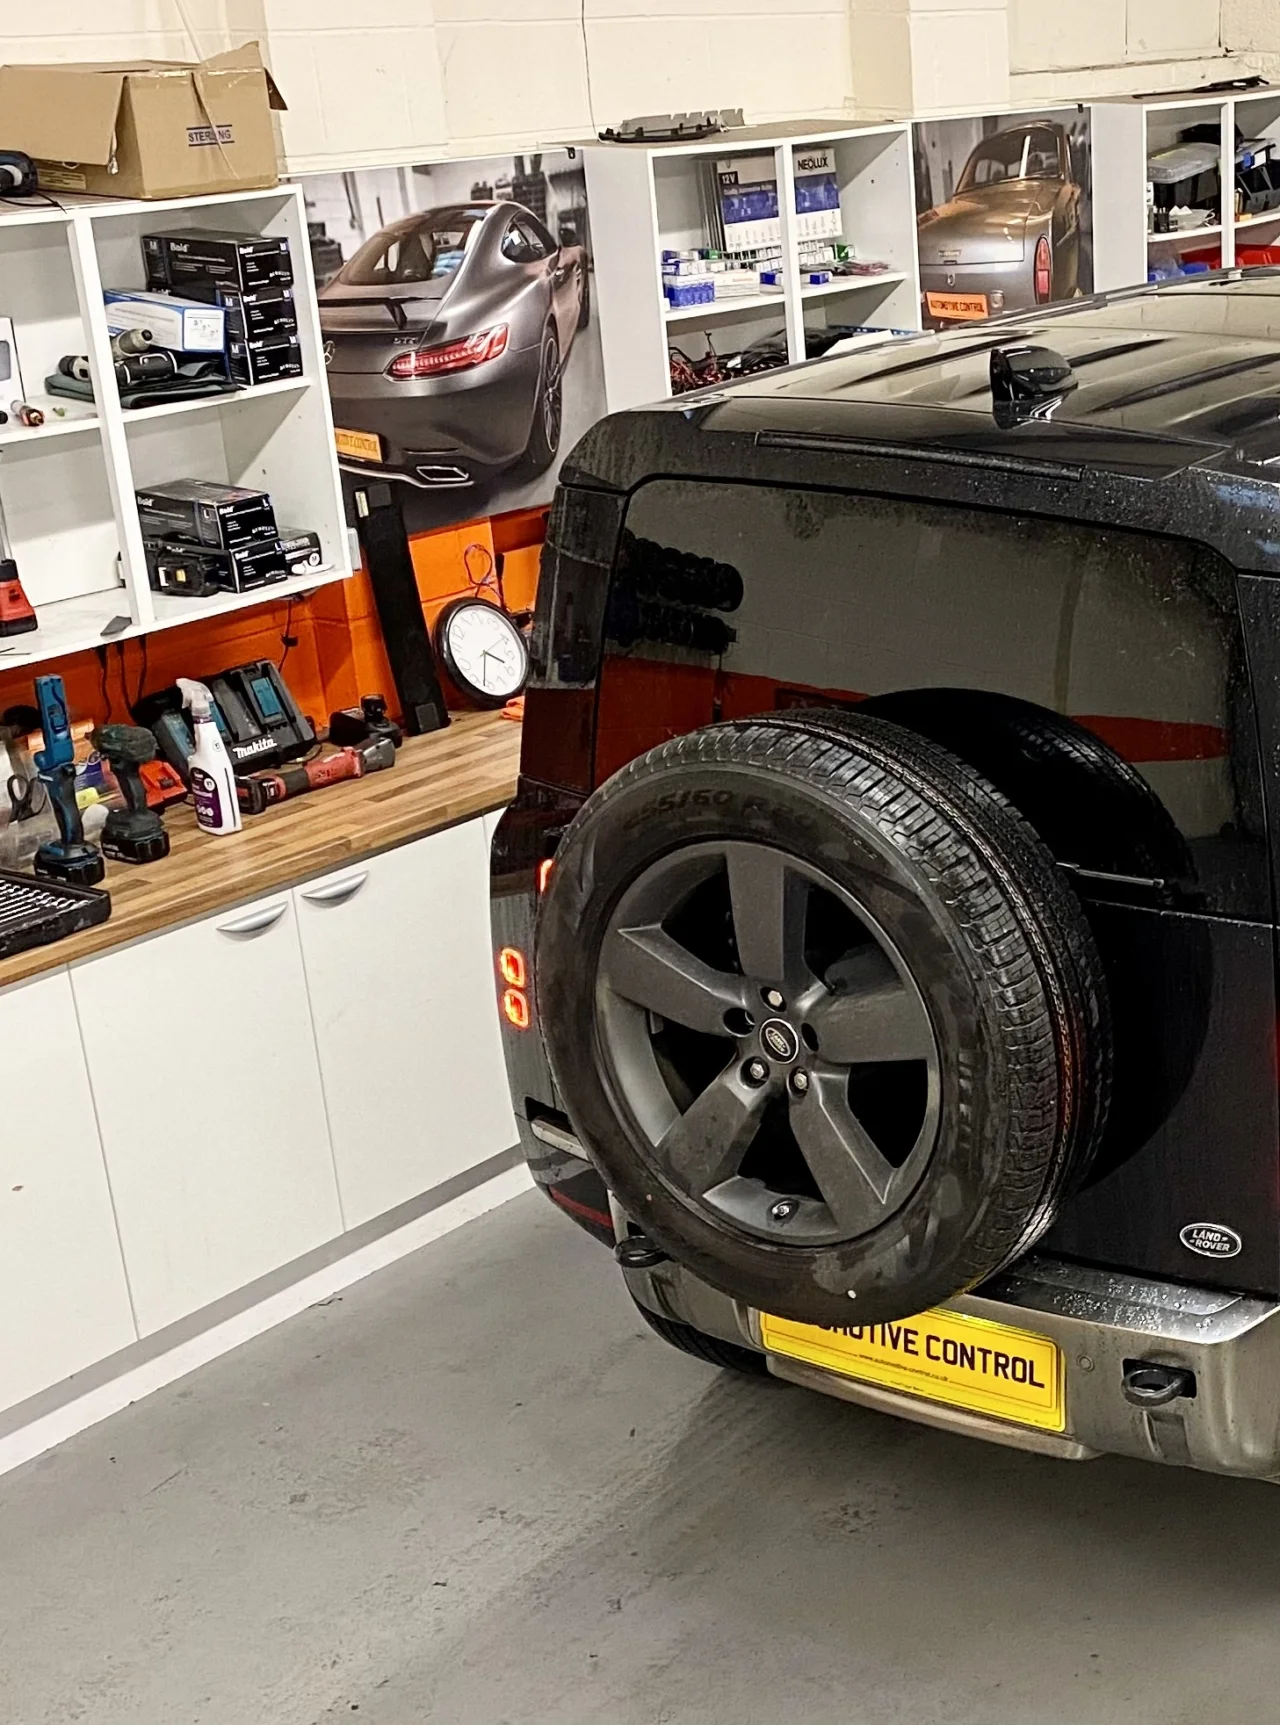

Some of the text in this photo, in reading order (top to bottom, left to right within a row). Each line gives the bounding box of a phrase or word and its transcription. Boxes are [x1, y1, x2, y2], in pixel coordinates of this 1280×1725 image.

[188, 129, 232, 142] STERLNG
[797, 156, 829, 171] NEOLUX
[721, 173, 737, 185] 12V
[471, 612, 483, 625] 2
[487, 617, 500, 631] 3
[1192, 1229, 1222, 1242] LAND
[1195, 1239, 1230, 1252] ROVER
[925, 1333, 1045, 1389] CONTROL
